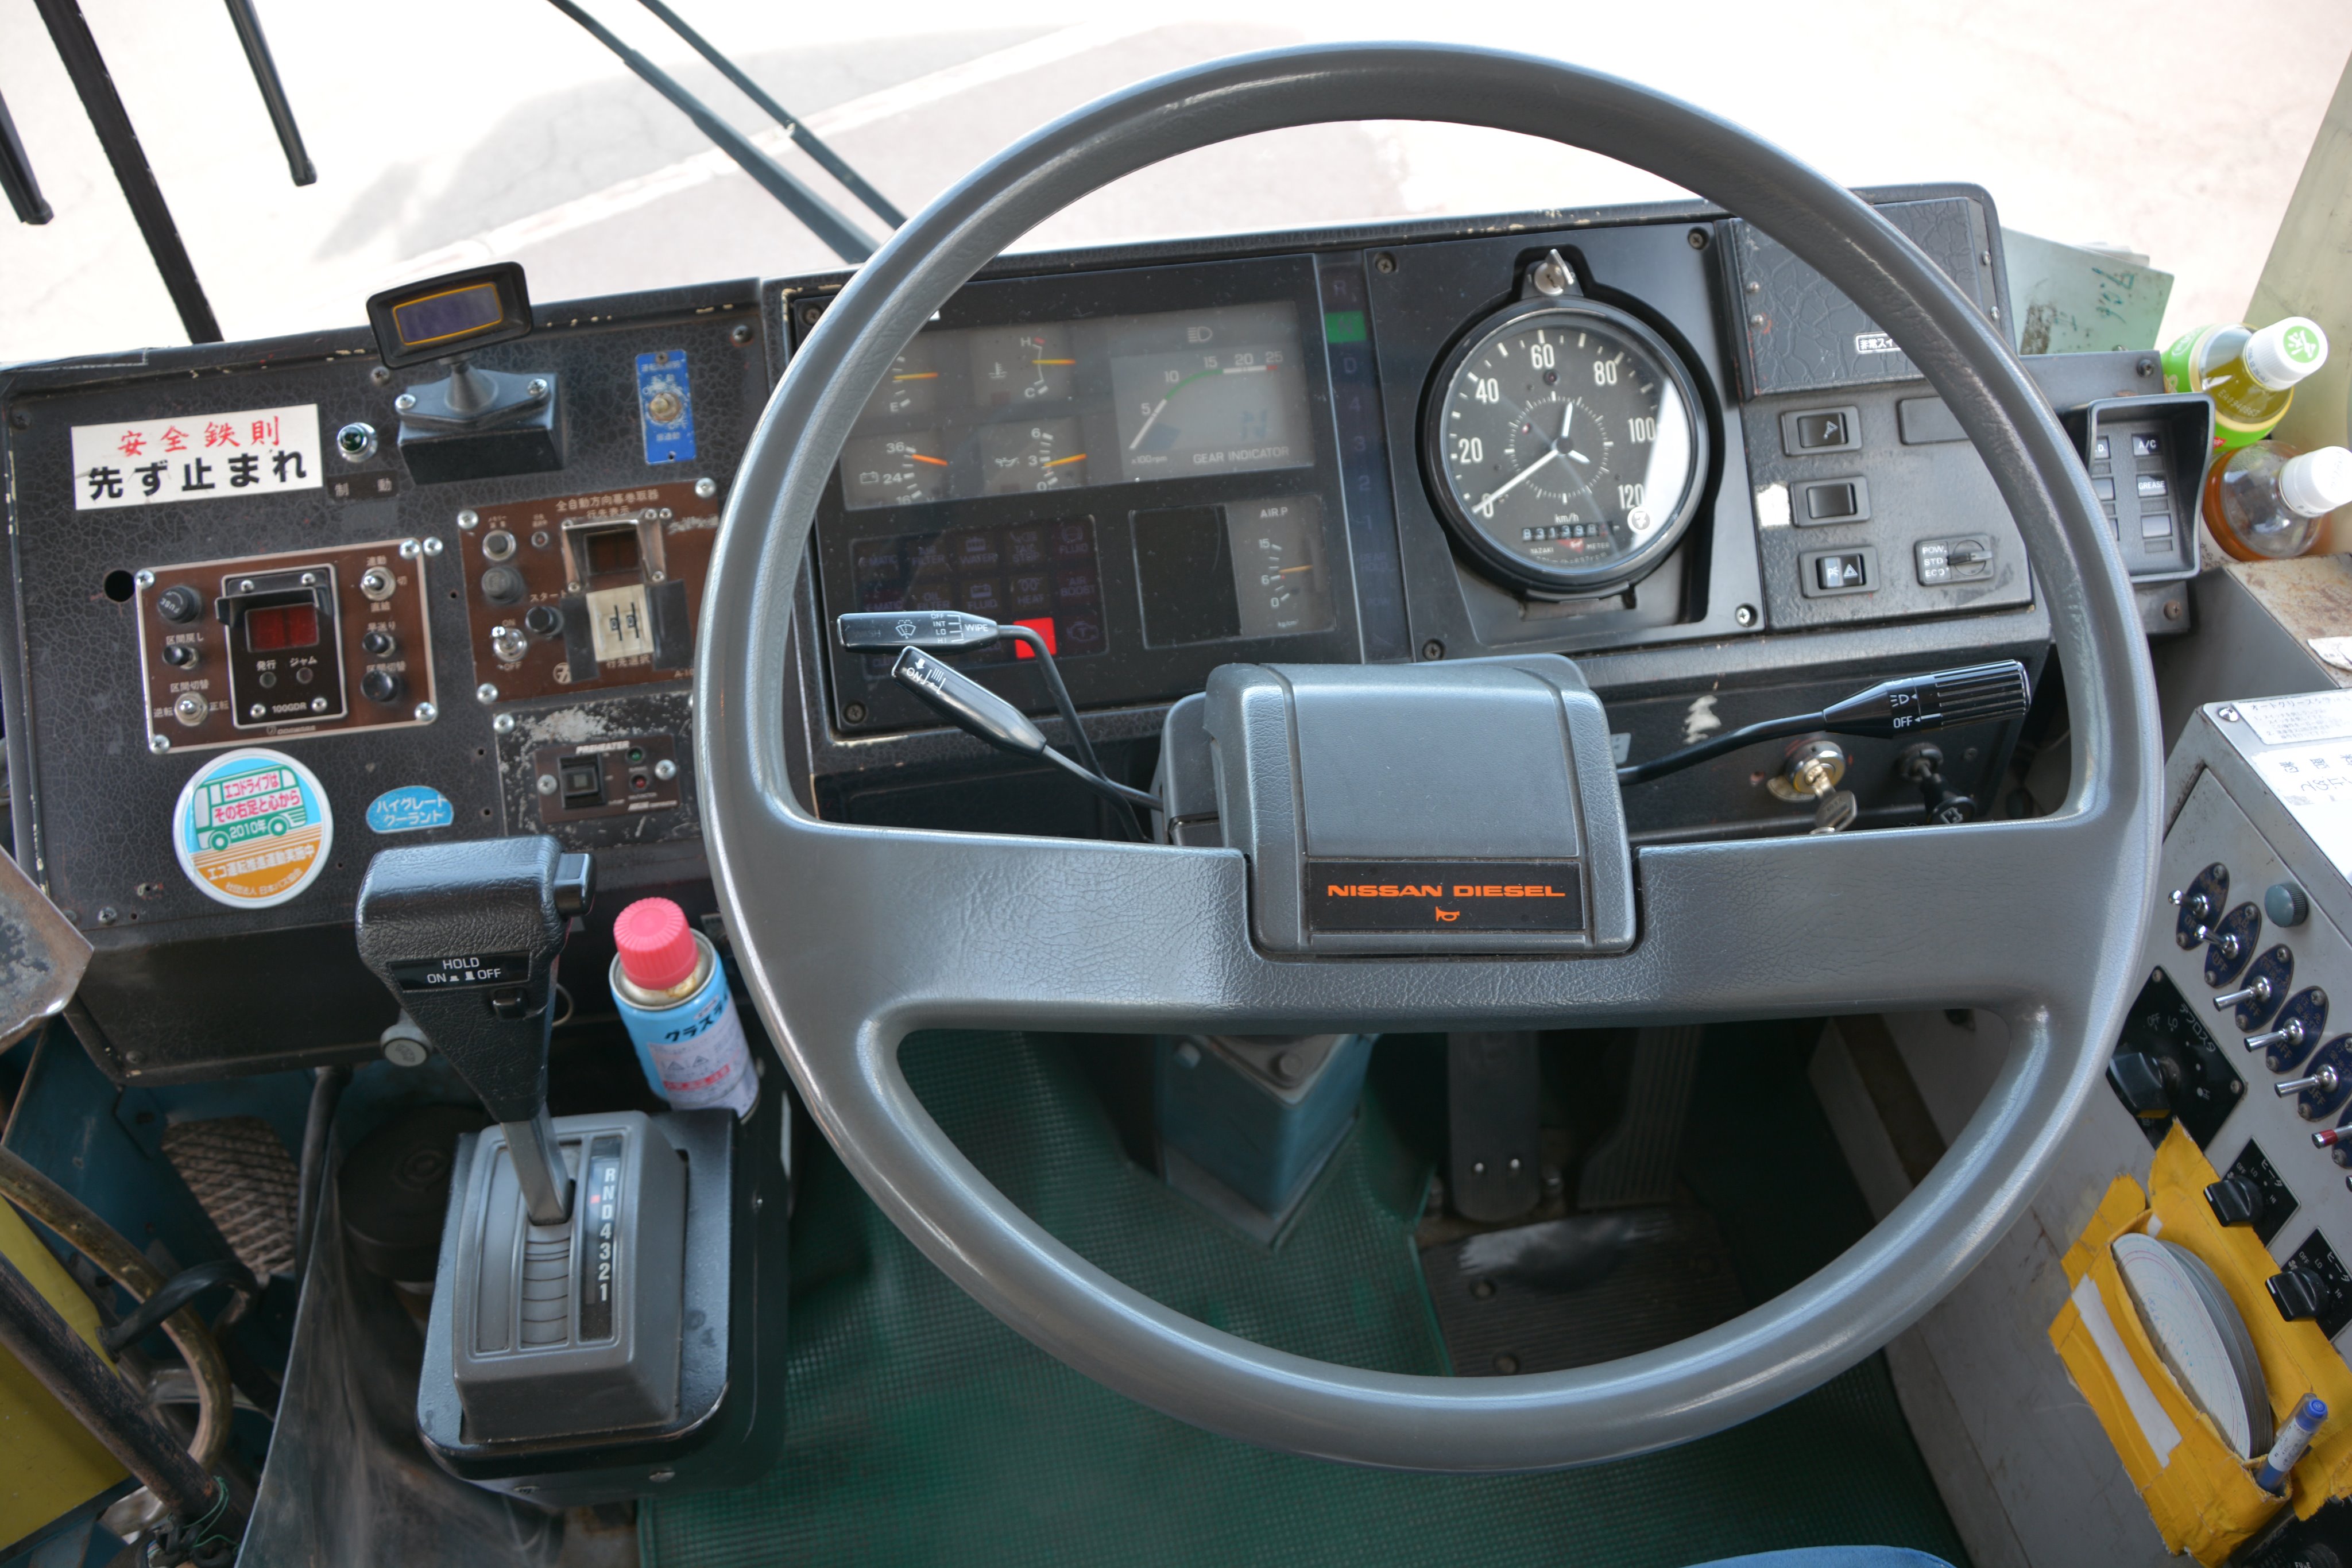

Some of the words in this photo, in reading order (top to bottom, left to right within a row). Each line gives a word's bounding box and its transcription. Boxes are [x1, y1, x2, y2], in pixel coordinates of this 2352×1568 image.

[1333, 280, 1347, 296] R
[1337, 318, 1353, 335] N
[1021, 338, 1031, 346] H
[1204, 356, 1218, 368] 15
[1235, 354, 1254, 366] 20
[1266, 351, 1283, 362] 25
[1531, 344, 1555, 369] 60
[1343, 357, 1357, 373] D
[1165, 370, 1179, 382] 10
[1594, 360, 1618, 386] 80
[1024, 388, 1035, 398] C
[1476, 378, 1499, 404] 40
[890, 402, 899, 412] E
[1141, 403, 1151, 415] 5
[1349, 396, 1361, 411] 4
[1031, 428, 1040, 438] 6
[1628, 417, 1657, 443] 100
[118, 416, 280, 457] 安全鉄則
[886, 442, 905, 453] 36
[1353, 436, 1366, 451] 3
[2139, 439, 2156, 449] A/C
[1193, 452, 1224, 464] GEAR
[1228, 446, 1289, 462] INDICATOR
[1459, 437, 1483, 464] 20
[1028, 456, 1038, 466] 3
[88, 450, 307, 500] 先ず止まれ
[883, 474, 902, 483] 24
[1359, 475, 1371, 491] 2
[2138, 481, 2165, 489] GREASE
[896, 495, 911, 505] 16
[1618, 483, 1645, 510] 120
[1481, 493, 1494, 518] 0
[1366, 515, 1372, 531] 1
[1554, 512, 1579, 524] km/h
[1059, 543, 1088, 554] FLUID
[1259, 538, 1270, 548] 15
[1922, 546, 1947, 555] POW.
[912, 555, 945, 566] FILTER
[961, 554, 996, 565] WATER
[1924, 557, 1944, 566] STD
[1925, 567, 1945, 577] ECO
[1069, 576, 1086, 586] AIR
[1262, 575, 1269, 585] 6
[1061, 586, 1095, 597] BOOST
[160, 598, 181, 614] FUSE
[917, 601, 950, 611] FILTER
[968, 599, 998, 610] FLUID
[1018, 596, 1044, 605] HEAT
[1271, 597, 1279, 607] 0
[368, 621, 396, 632] 早送り
[502, 618, 516, 627] ON
[965, 624, 988, 632] WIPE
[166, 633, 204, 645] 区間戻し
[257, 660, 276, 671] 発行
[290, 655, 318, 667] ジャム
[504, 661, 522, 671] OFF
[906, 667, 923, 682] ON
[170, 680, 210, 692] 区間切替
[210, 700, 229, 711] 正転
[154, 706, 173, 718] 逆転
[1893, 715, 1913, 729] OFF
[575, 740, 630, 754] PREHEATER
[223, 773, 280, 800] エコドライブは
[214, 788, 301, 823] その右足と心から
[384, 810, 443, 826] クーラント
[229, 819, 268, 839] 2010年
[1328, 885, 1442, 897] NISSAN
[1453, 885, 1566, 897] DIESEL
[443, 957, 480, 970] HOLD
[2212, 953, 2228, 971] OFF
[427, 973, 446, 984] ON
[477, 969, 501, 979] OFF
[2147, 1013, 2161, 1025] OFF
[2168, 1015, 2178, 1028] LO
[2180, 1004, 2215, 1052] デフロスタ
[2236, 1162, 2246, 1175] OFF
[2250, 1167, 2258, 1178] LO
[2261, 1159, 2283, 1187] ヒータ
[605, 1168, 616, 1182] R
[603, 1186, 615, 1200] N
[2269, 1194, 2277, 1205] HI
[602, 1205, 613, 1219] D
[599, 1223, 612, 1239] 4
[599, 1242, 611, 1260] 3
[2299, 1251, 2310, 1265] OFF
[2315, 1258, 2323, 1269] LO
[598, 1263, 610, 1280] 2
[2327, 1251, 2351, 1282] ヒータ
[600, 1283, 608, 1301] 1
[2335, 1288, 2343, 1299] HI
